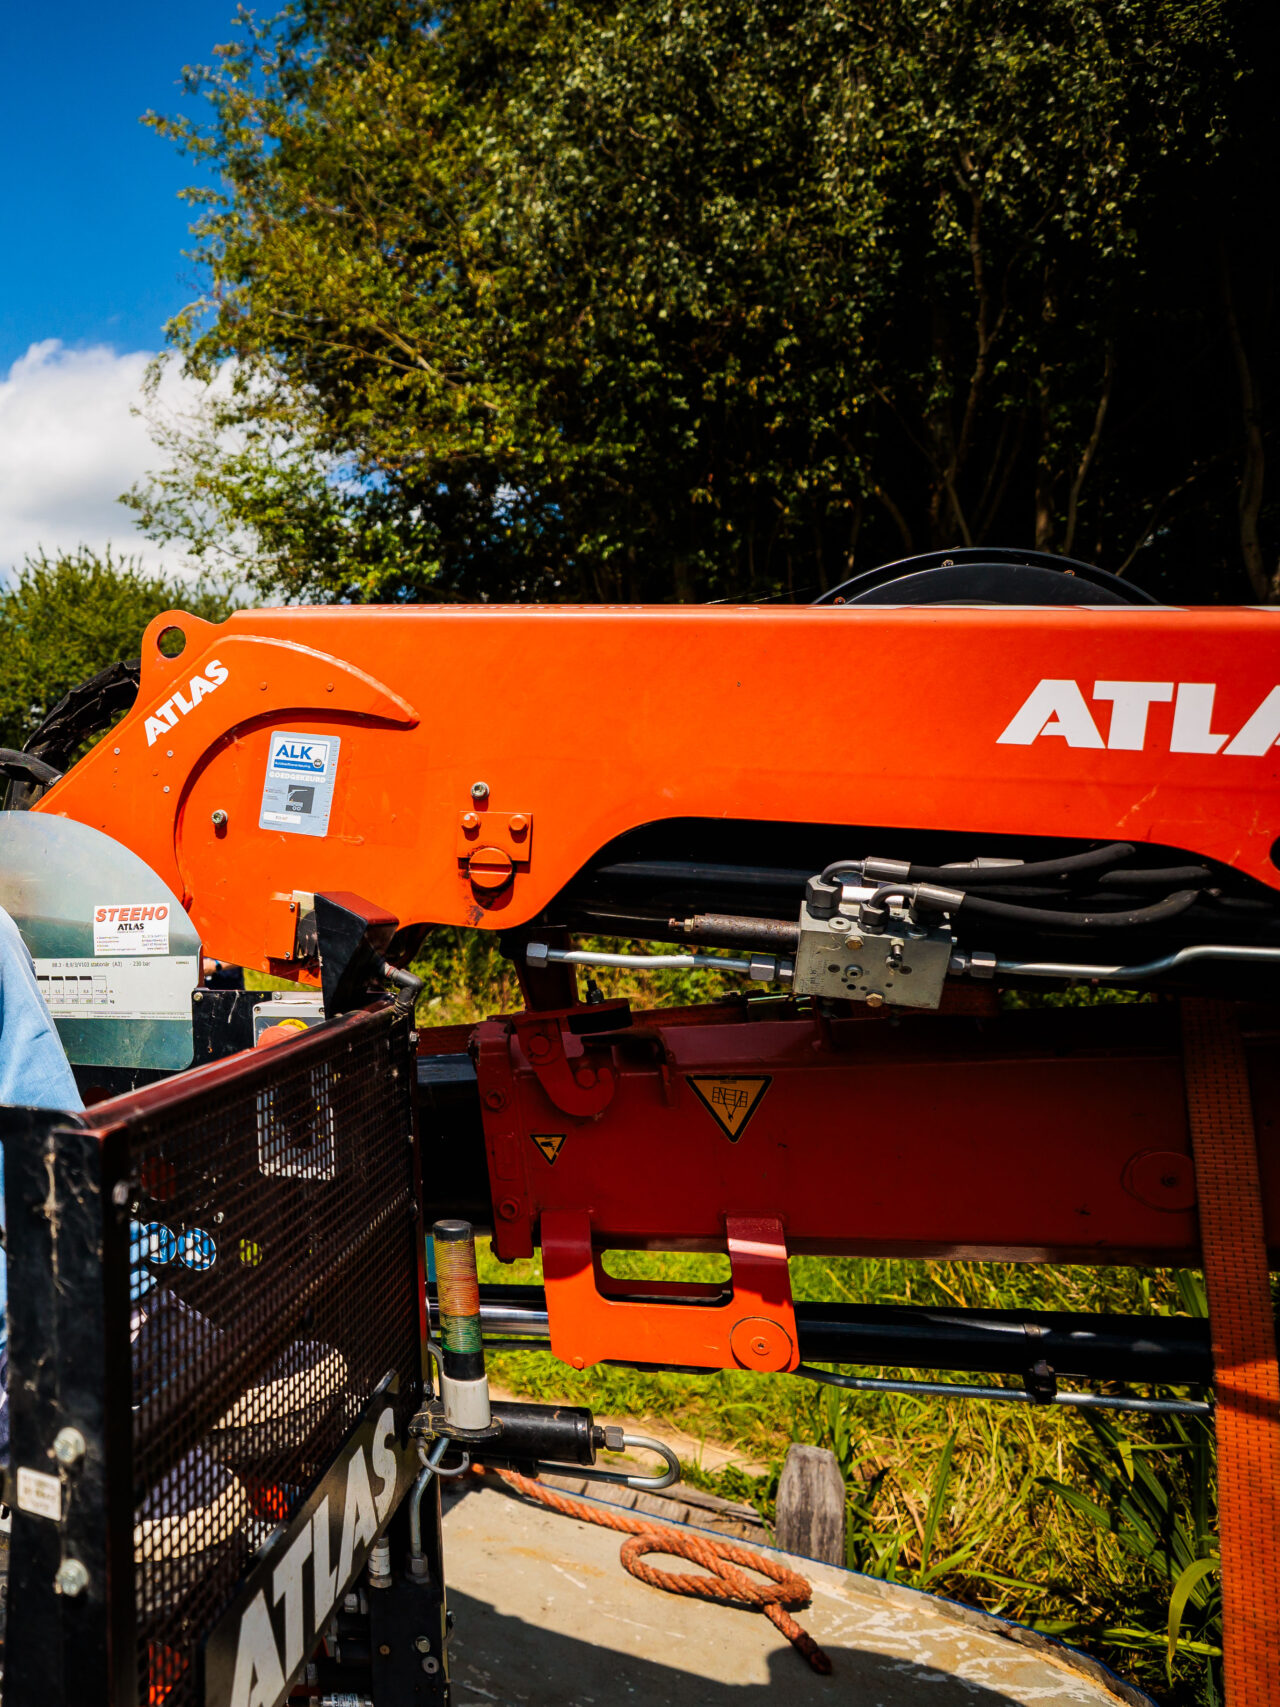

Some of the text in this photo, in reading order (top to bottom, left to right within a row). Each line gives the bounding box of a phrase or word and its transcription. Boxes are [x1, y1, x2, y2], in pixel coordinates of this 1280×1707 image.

[143, 659, 229, 747] ATLAS
[275, 743, 313, 760] ALK
[95, 905, 169, 922] STEEHO
[117, 922, 145, 931] ATLAS
[231, 1407, 397, 1707] ATLAS
